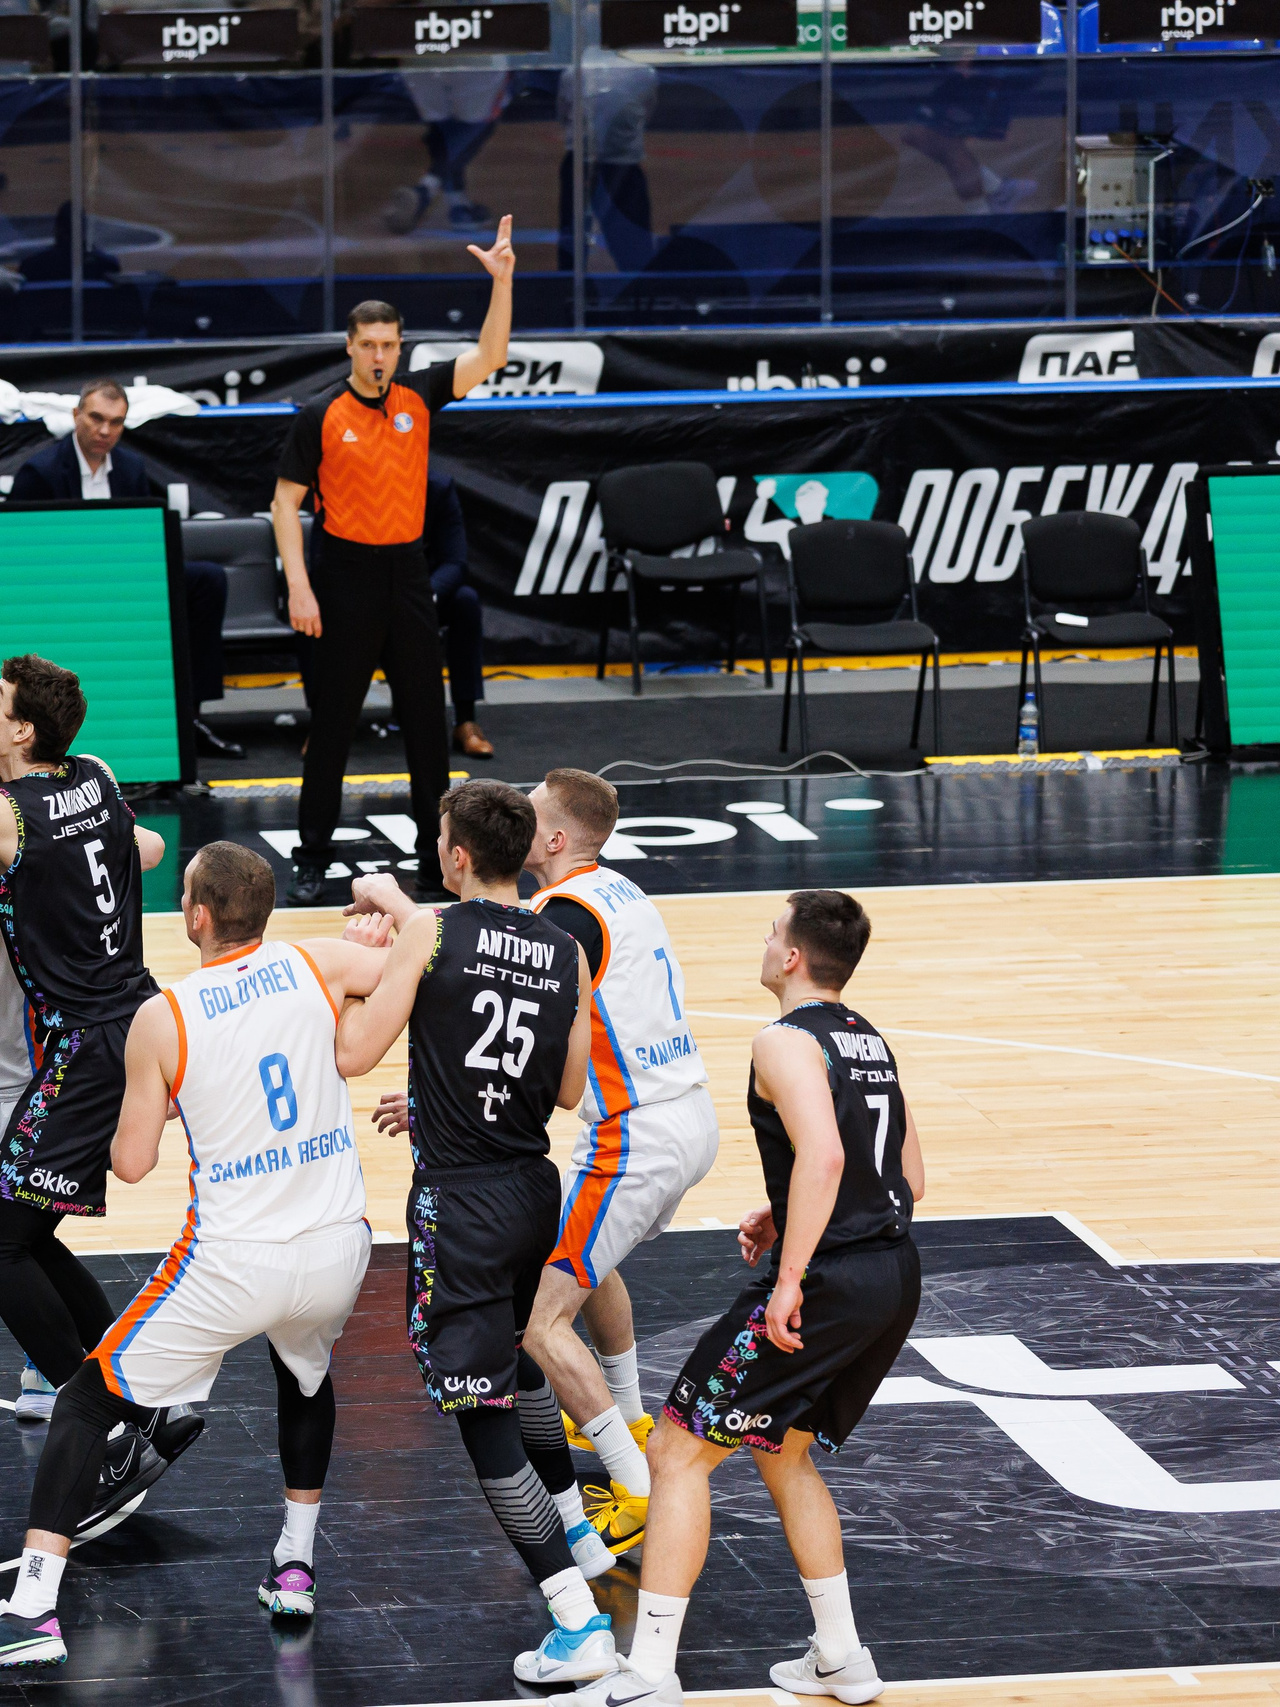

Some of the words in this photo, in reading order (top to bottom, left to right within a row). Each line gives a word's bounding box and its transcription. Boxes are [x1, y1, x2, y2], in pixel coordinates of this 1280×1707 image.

[163, 17, 241, 54] rbpi
[415, 10, 493, 48] rbpi
[664, 3, 741, 41] rbpi
[908, 1, 985, 39] rbpi
[1161, 0, 1236, 34] rbpi
[53, 809, 111, 840] JETOUR
[83, 838, 116, 914] 5
[476, 928, 555, 971] ANTIPOV
[199, 958, 298, 1020] GOLDYREV
[463, 962, 561, 994] JETOUR
[464, 989, 541, 1079] 25
[635, 1033, 696, 1071] SAMARA
[258, 1052, 298, 1132] 8
[849, 1067, 898, 1083] JETOUR
[209, 1146, 293, 1184] SAMARA
[297, 1125, 353, 1165] REGION
[864, 1094, 890, 1178] 7
